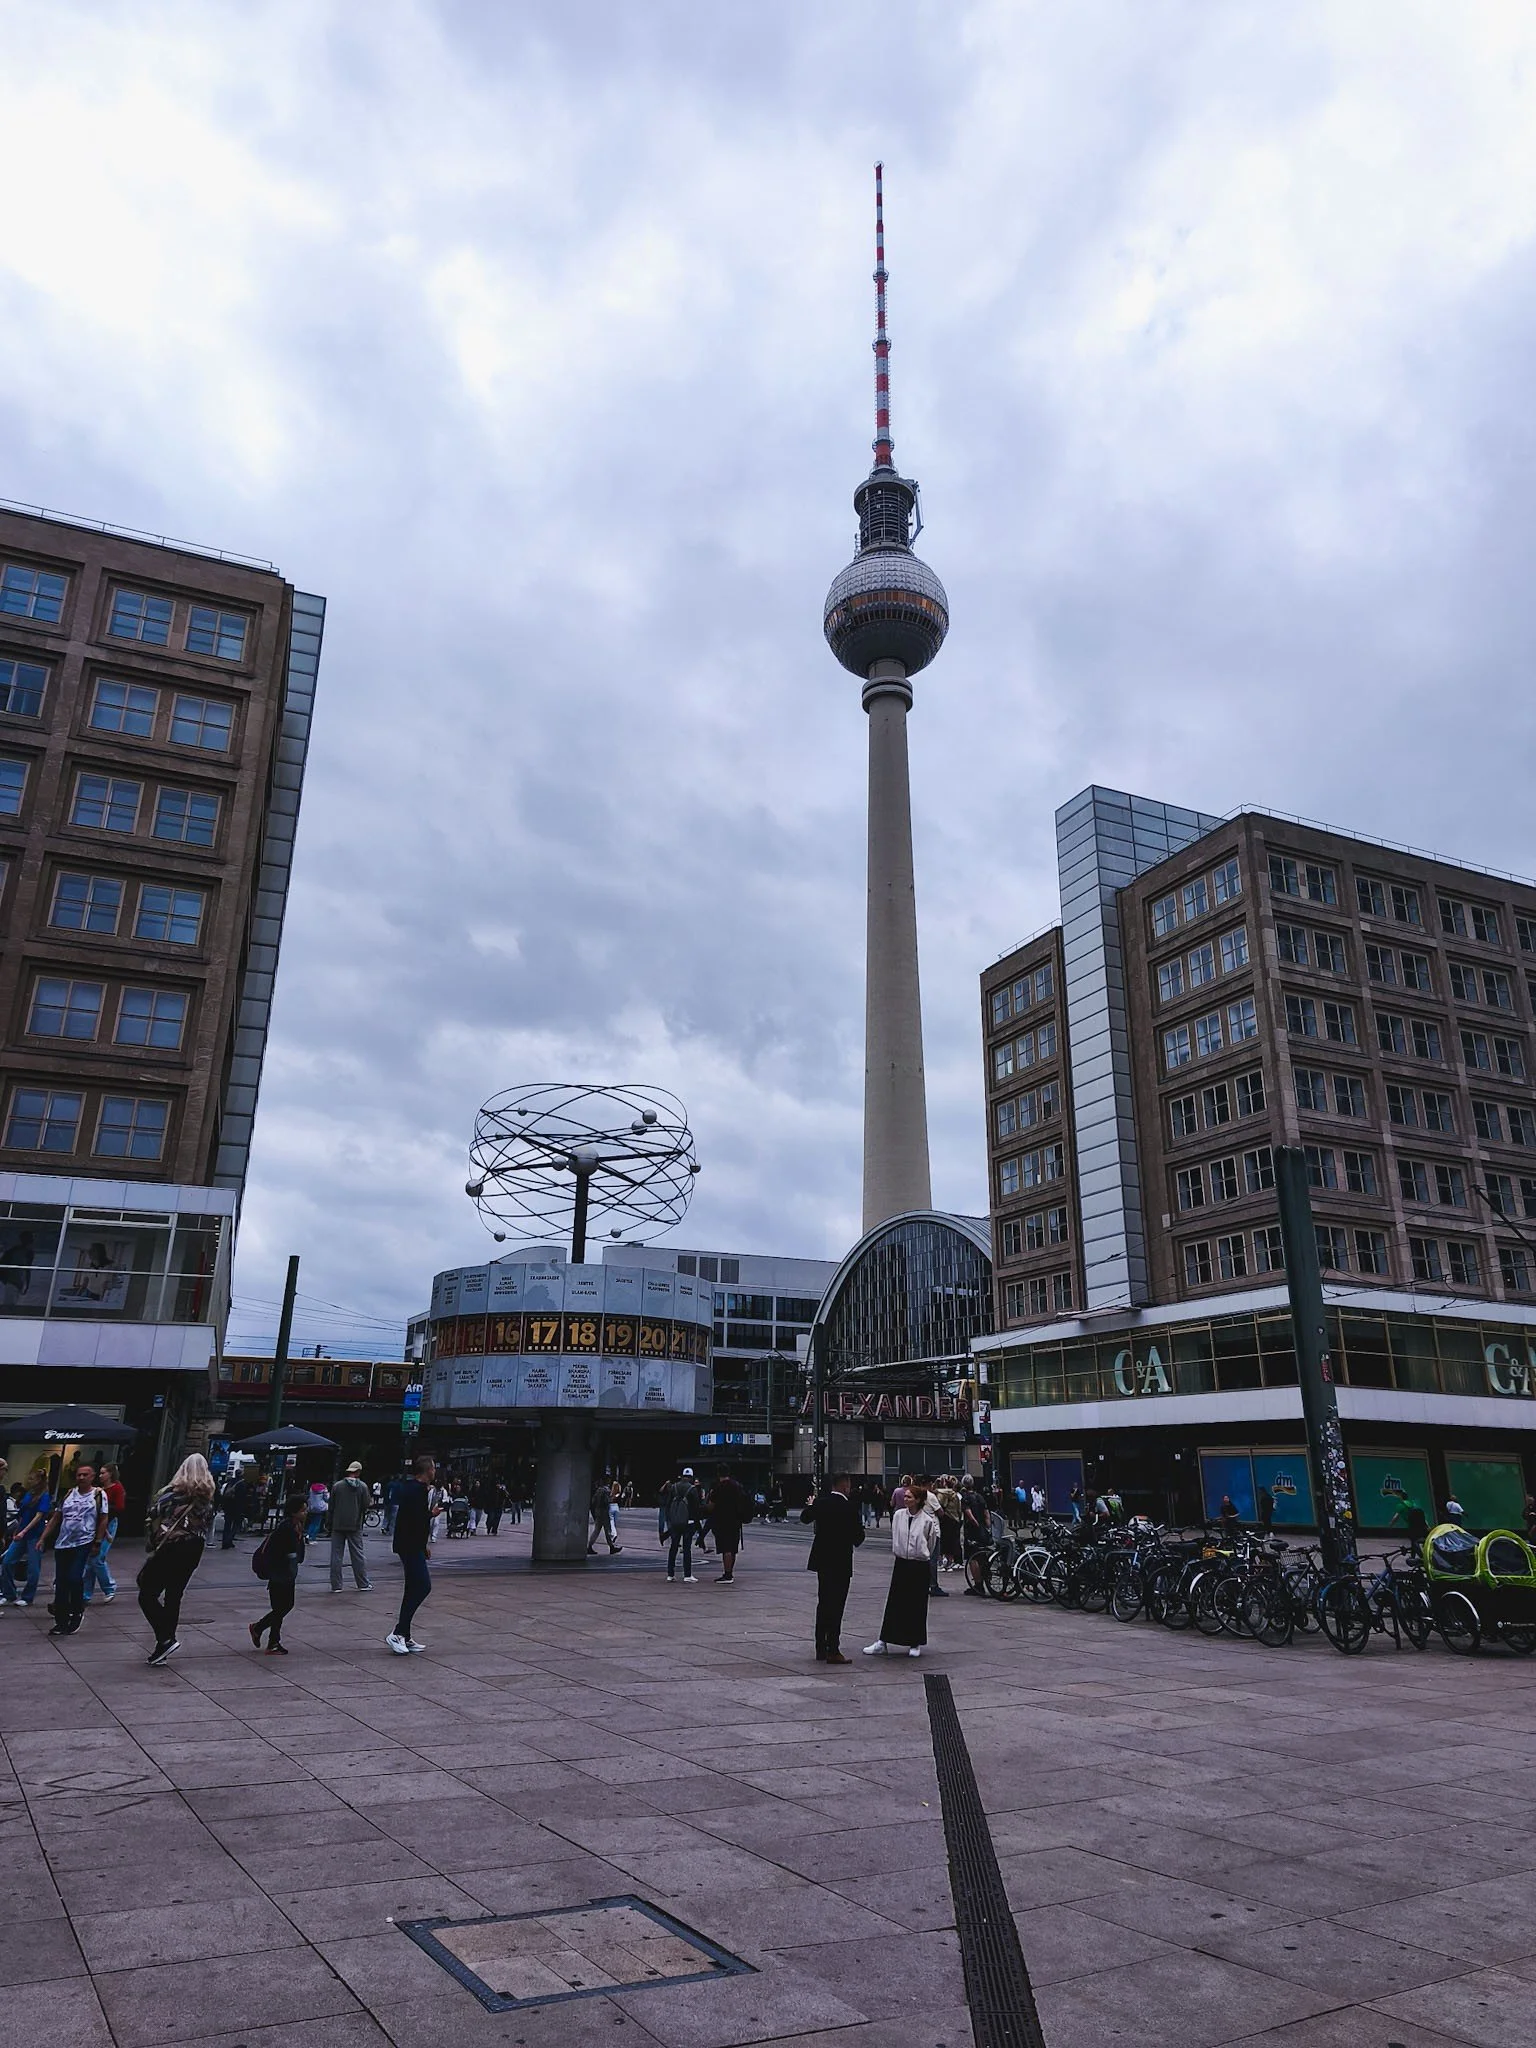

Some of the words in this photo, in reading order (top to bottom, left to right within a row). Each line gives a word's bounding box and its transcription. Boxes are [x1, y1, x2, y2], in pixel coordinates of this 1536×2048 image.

[495, 1322, 520, 1345] 16
[530, 1321, 560, 1344] 17
[568, 1322, 596, 1346] 18
[606, 1324, 633, 1347] 19
[640, 1326, 666, 1350] 20
[669, 1329, 687, 1353] 21
[1114, 1346, 1172, 1395] C&A
[405, 1384, 423, 1393] AfD
[801, 1390, 969, 1421] ALEXANDER
[56, 1432, 85, 1440] Tchibo
[1276, 1472, 1293, 1487] dm
[1385, 1475, 1401, 1490] dm
